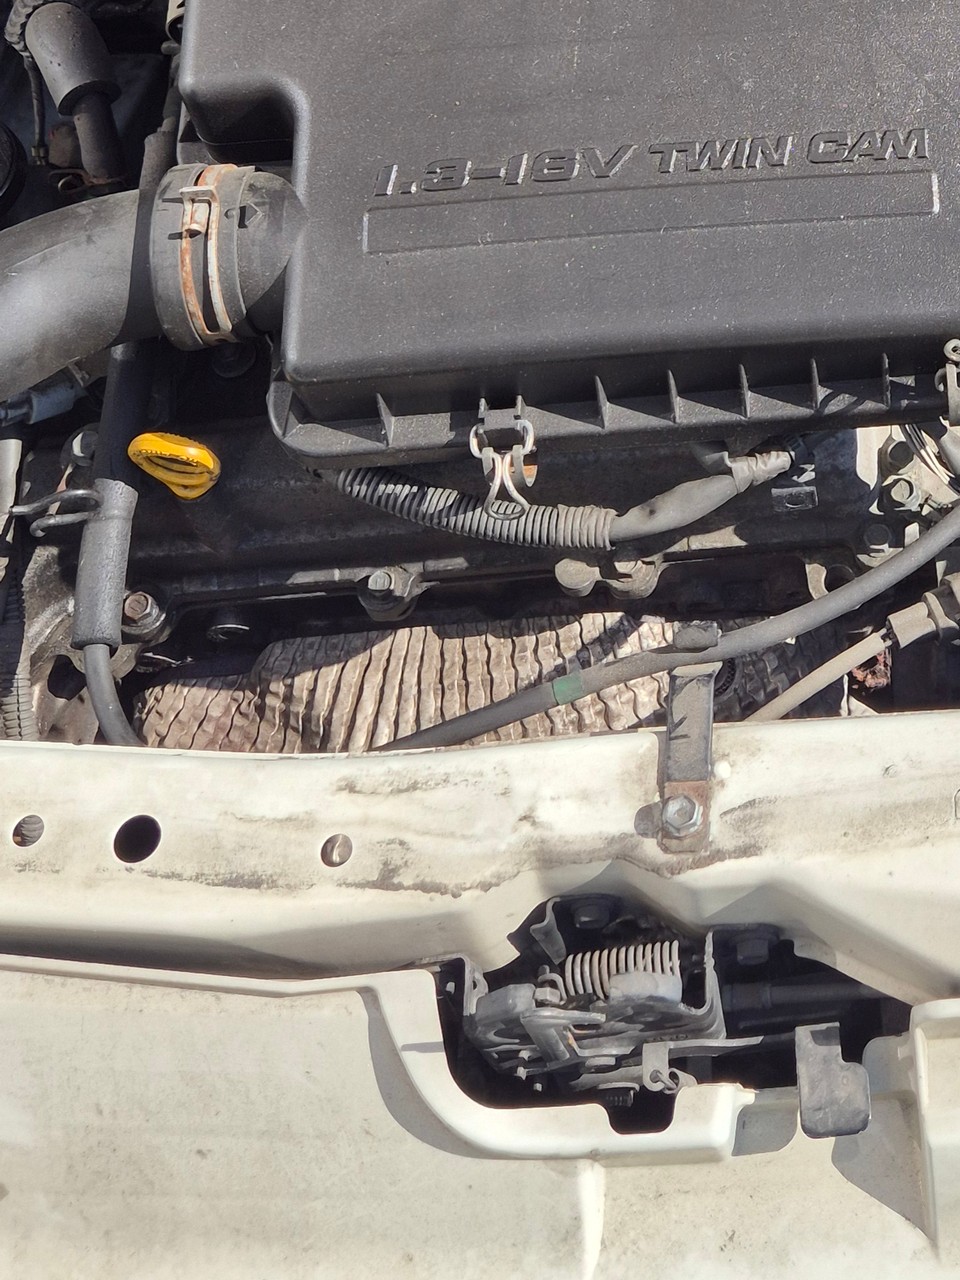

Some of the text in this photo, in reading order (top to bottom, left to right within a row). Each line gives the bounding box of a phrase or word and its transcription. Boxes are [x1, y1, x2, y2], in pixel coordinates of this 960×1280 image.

[373, 128, 930, 197] 1.3-16V TWIN CAM
